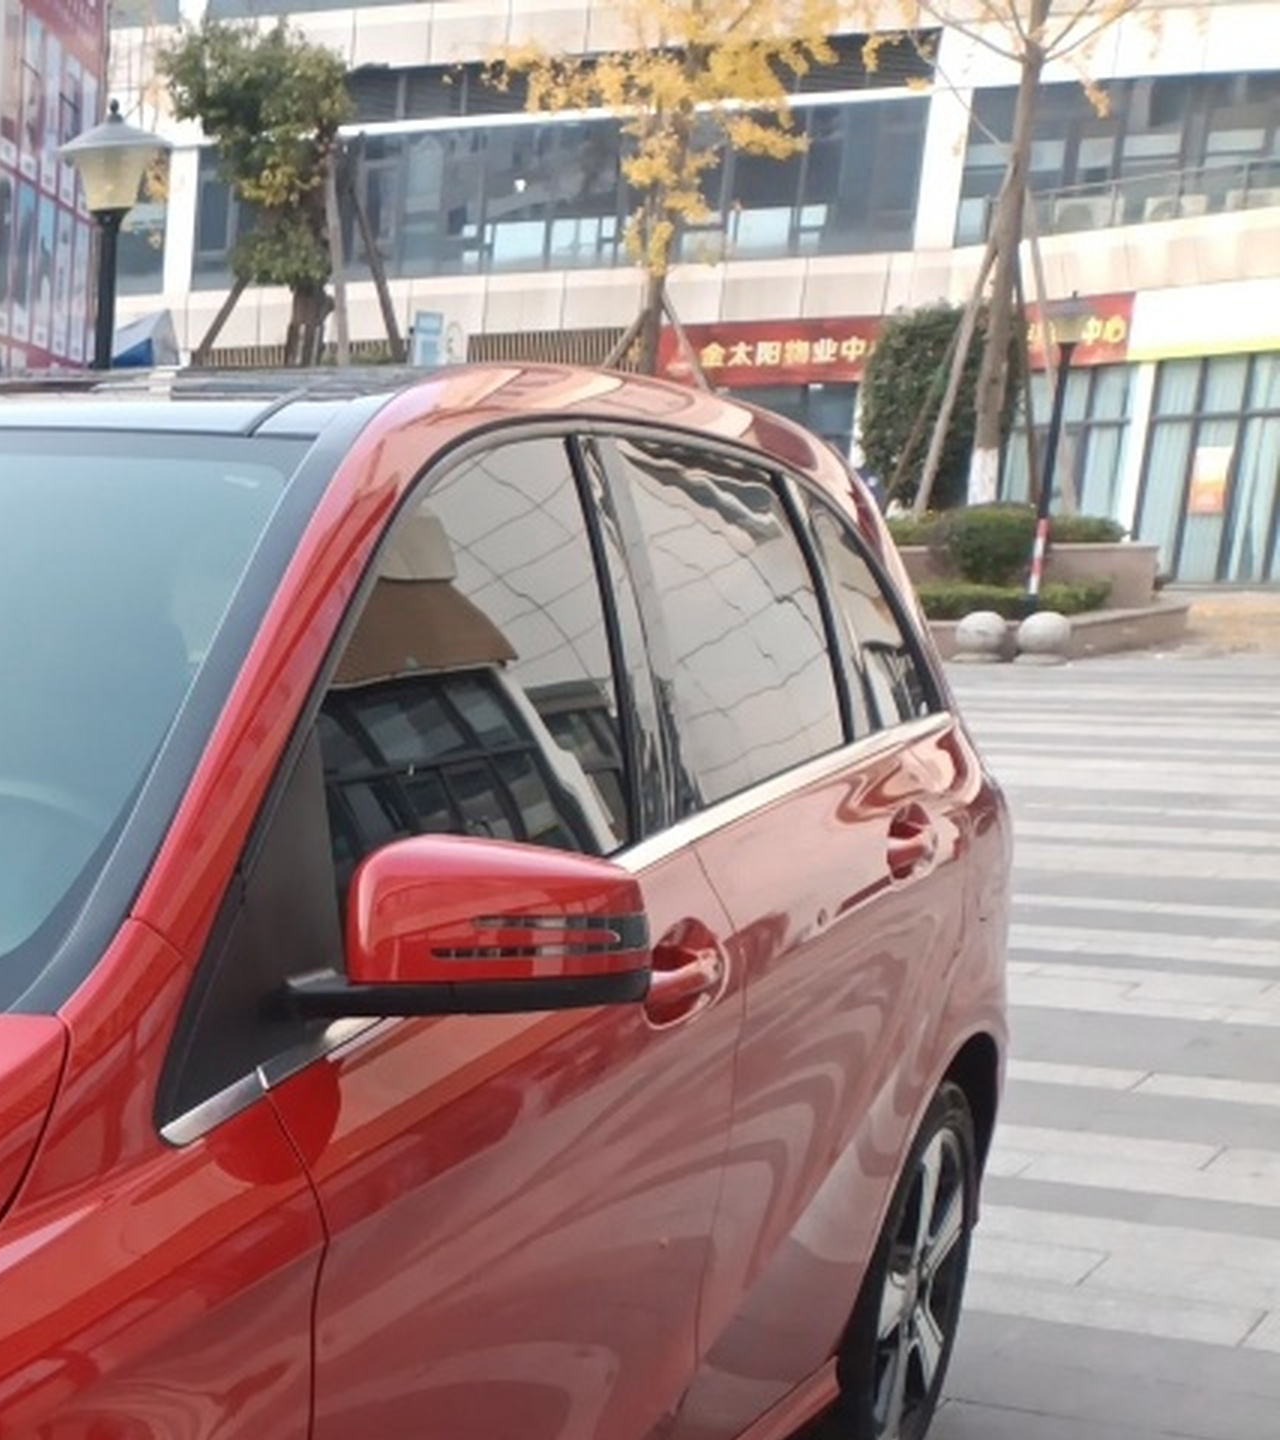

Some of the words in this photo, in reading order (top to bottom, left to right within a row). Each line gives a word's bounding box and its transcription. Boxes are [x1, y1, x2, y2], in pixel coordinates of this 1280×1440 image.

[699, 334, 877, 368] 金太阳物业中
